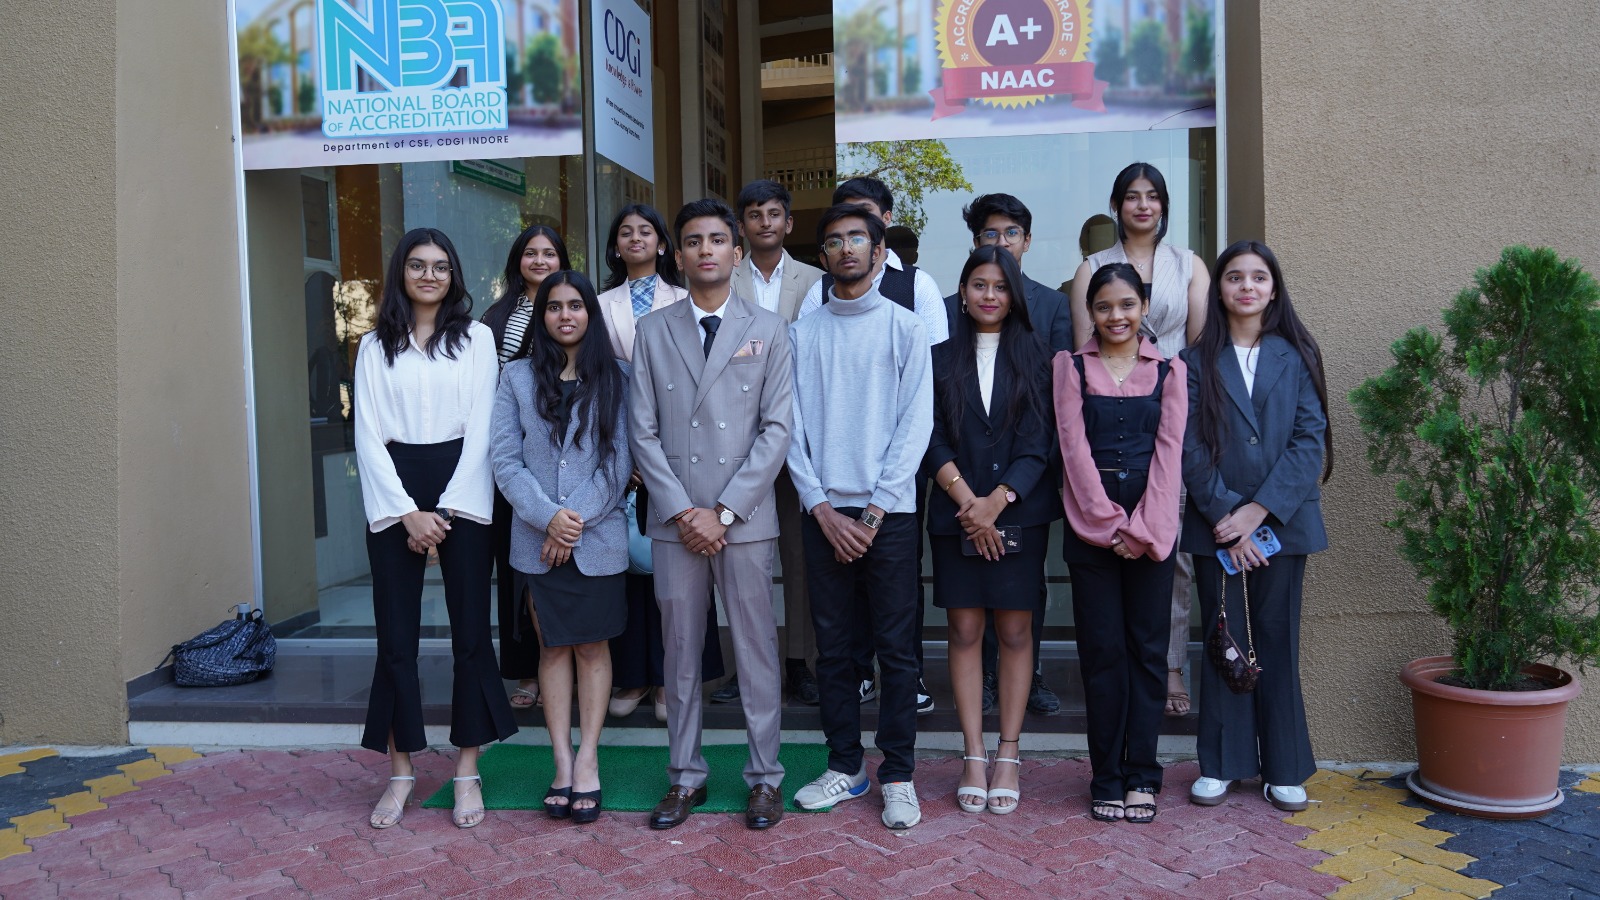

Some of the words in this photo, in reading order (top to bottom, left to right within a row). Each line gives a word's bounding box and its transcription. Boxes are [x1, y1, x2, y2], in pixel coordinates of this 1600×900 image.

[985, 14, 1042, 47] A+
[322, 0, 501, 91] NBA
[981, 68, 1055, 90] NAAC
[328, 96, 427, 115] NATIONAL
[432, 91, 502, 110] BOARD
[328, 122, 344, 133] OF
[348, 109, 502, 132] ACCREDITATION
[323, 141, 390, 153] Department
[394, 139, 405, 149] of
[409, 139, 433, 149] CSE,
[437, 137, 464, 147] CDGI
[468, 135, 509, 146] INDORE
